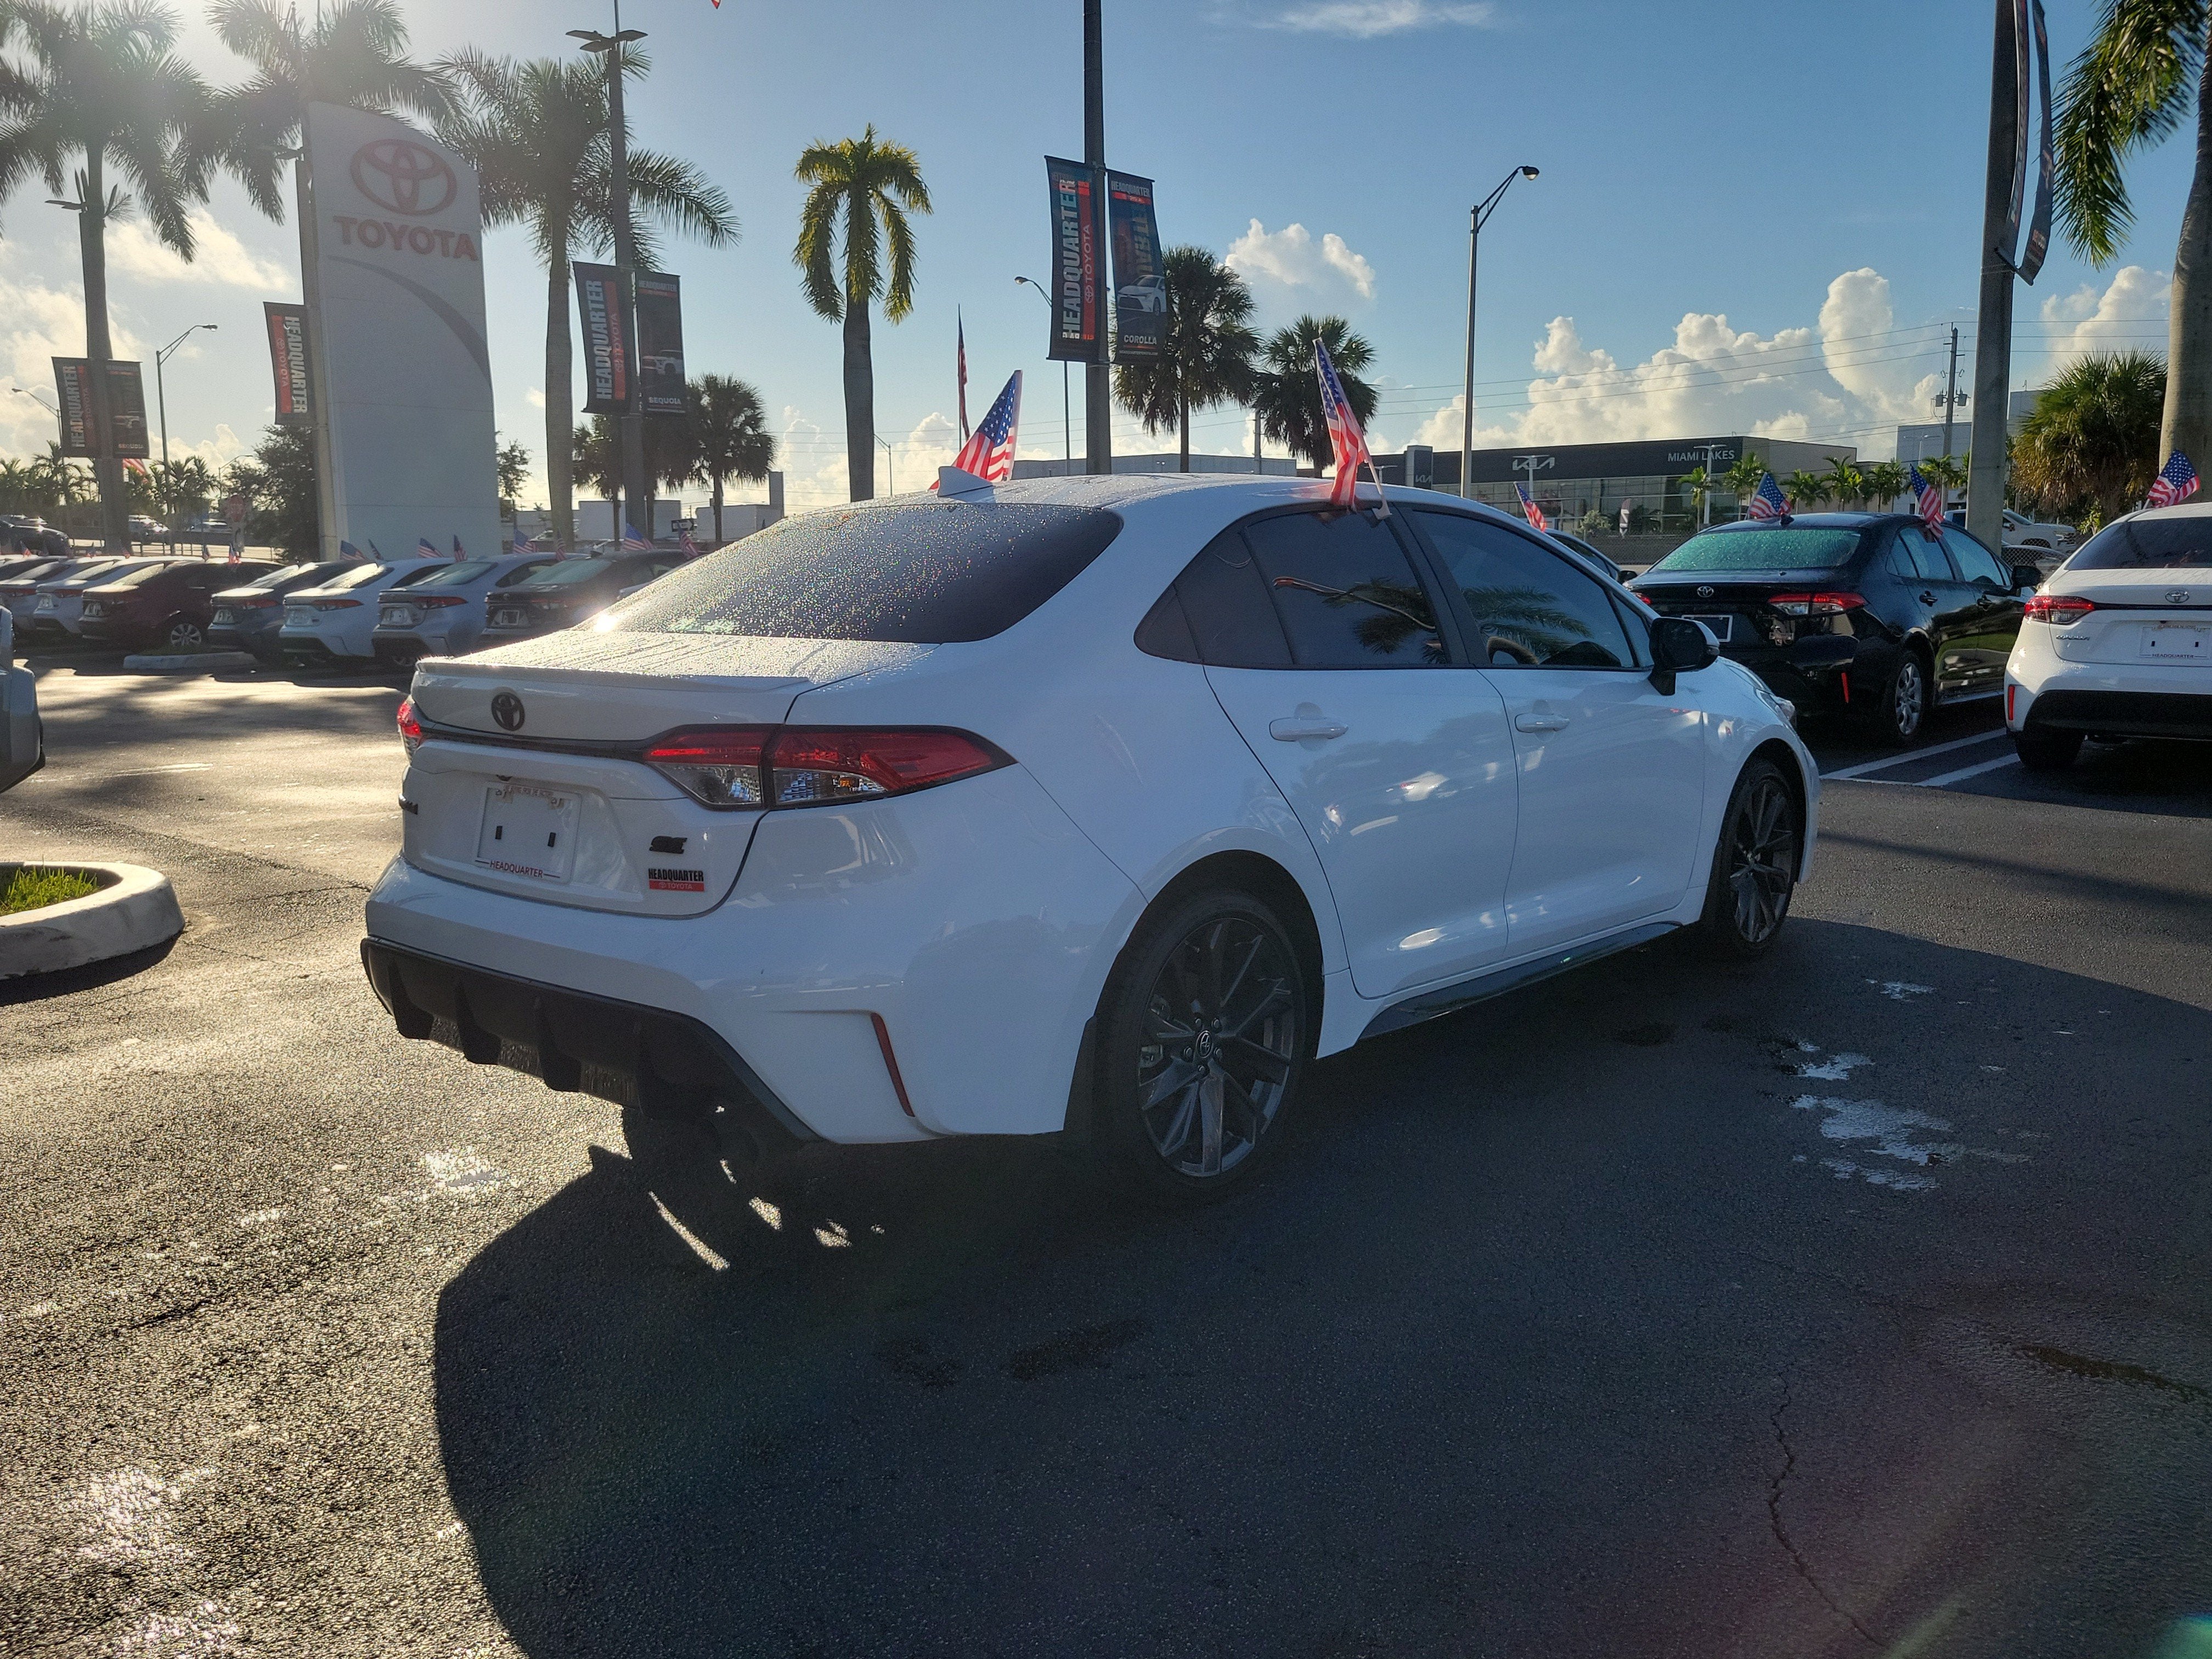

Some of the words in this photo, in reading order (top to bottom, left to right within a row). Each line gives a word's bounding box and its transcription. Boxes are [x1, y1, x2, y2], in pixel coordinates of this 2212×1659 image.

[1111, 180, 1150, 198] HEADQUARTER
[332, 216, 479, 262] TOYOTA
[1059, 180, 1082, 338] HEADQUARTER
[1082, 225, 1092, 283] TOYOTA
[586, 280, 613, 399] HEADQUARTER
[610, 313, 623, 358] TOYOTA
[1124, 335, 1157, 345] COROLLA
[278, 352, 290, 387] TOYOTA
[284, 316, 308, 413] HEADQUARTER
[63, 366, 85, 447] HEADQUARTER
[1668, 452, 1699, 461] MIAMI
[490, 860, 543, 878] HEADQUARTER
[648, 868, 704, 882] HEADQUARTER
